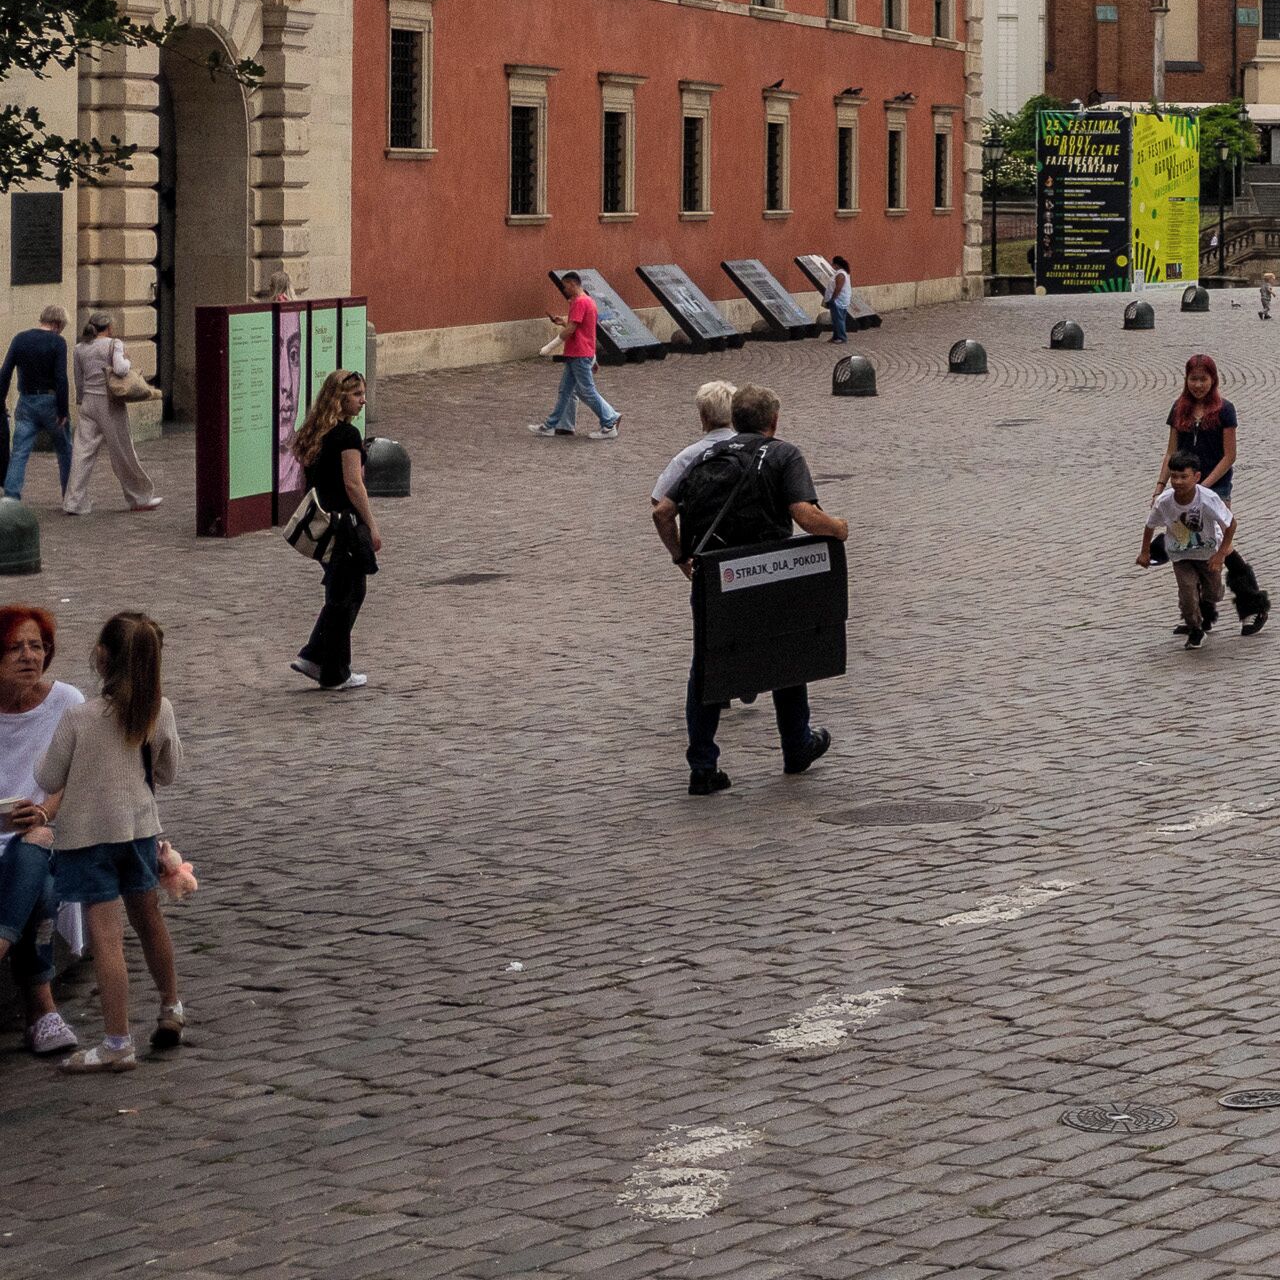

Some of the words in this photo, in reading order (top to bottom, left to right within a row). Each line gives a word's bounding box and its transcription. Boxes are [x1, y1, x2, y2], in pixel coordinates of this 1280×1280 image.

[1046, 120, 1064, 133] 25.
[1067, 120, 1120, 131] FESTIWAL
[1045, 135, 1092, 146] OGRODY
[1059, 144, 1120, 155] MUZYCZNE
[1148, 134, 1175, 160] FESTIWAL
[1045, 156, 1104, 166] FAJERWERKI
[1076, 163, 1119, 173] FANFARY
[1167, 155, 1194, 180] MUZYCZNE
[735, 552, 827, 579] STRAJK_DLA_POKOJU
